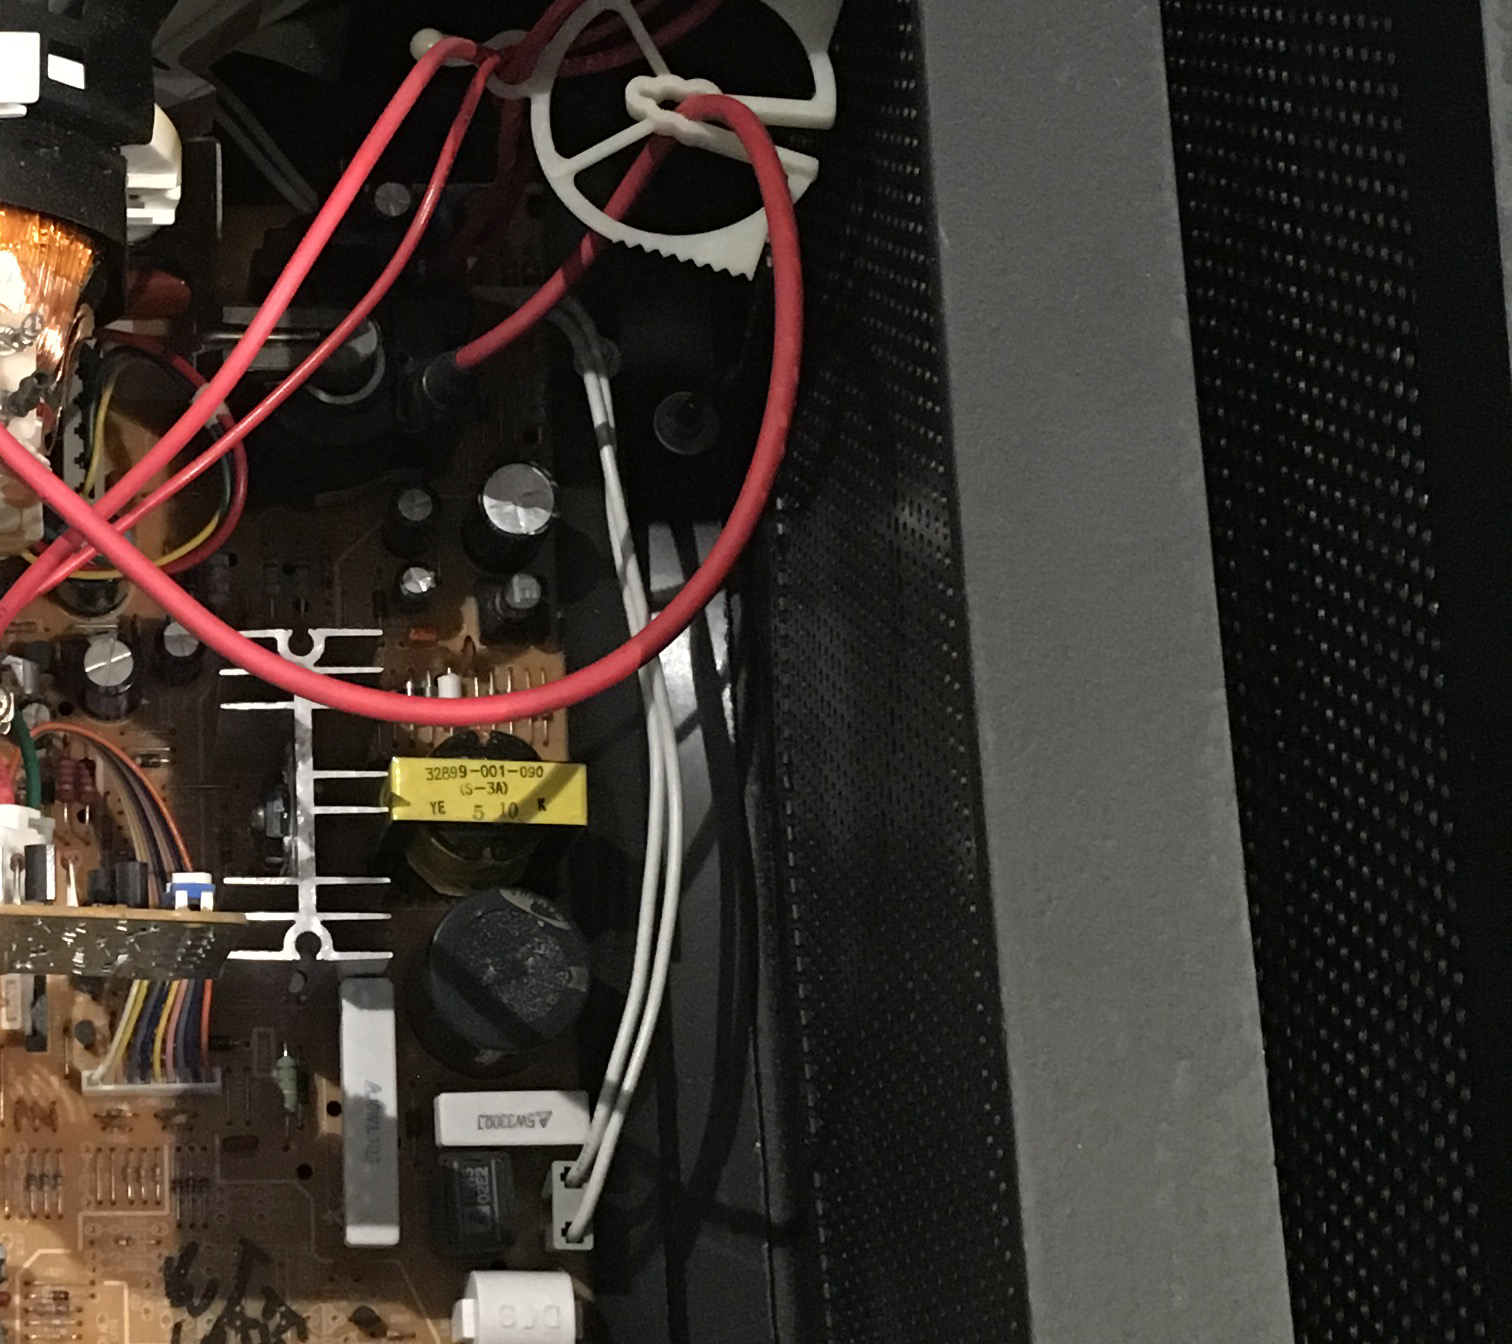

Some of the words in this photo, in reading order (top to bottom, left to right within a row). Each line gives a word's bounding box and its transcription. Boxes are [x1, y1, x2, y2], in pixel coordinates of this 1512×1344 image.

[424, 765, 545, 782] 32899-001-090
[459, 781, 509, 796] (S-3A)
[429, 800, 446, 816] YE
[472, 804, 485, 821] 5
[498, 801, 520, 820] 10
